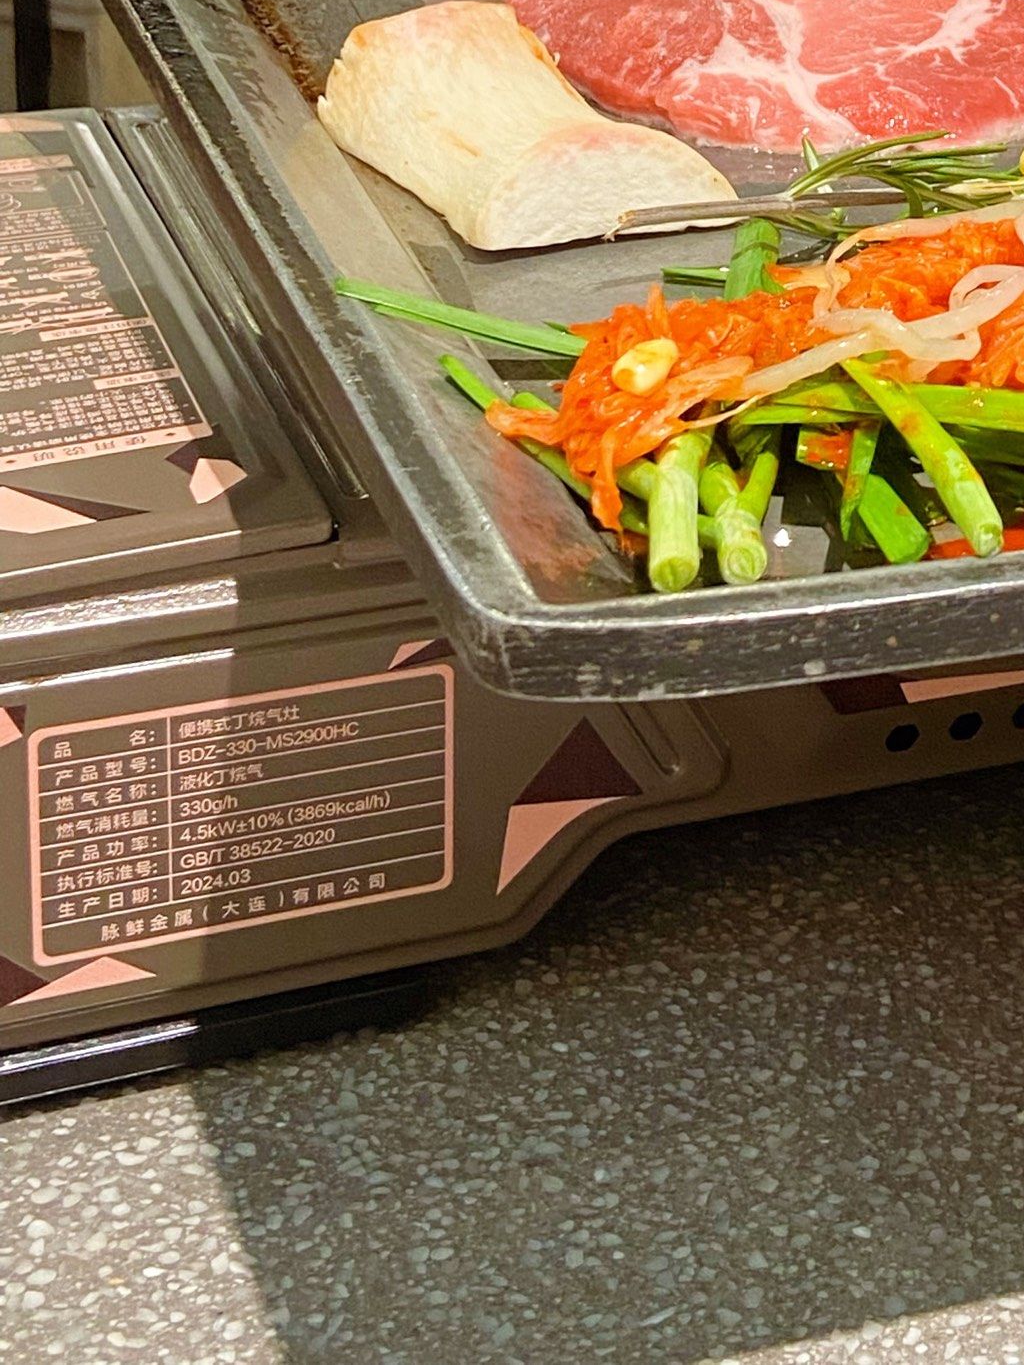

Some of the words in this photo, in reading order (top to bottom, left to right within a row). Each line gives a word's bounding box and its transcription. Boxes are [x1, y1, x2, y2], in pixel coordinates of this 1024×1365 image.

[178, 704, 300, 738] 便携式丁烷气灶
[178, 721, 360, 765] BDZ-330-MS2900HC
[179, 762, 265, 792] 液化丁烷气
[180, 794, 238, 818] 330g/h
[180, 811, 285, 842] 4.5kW±10%
[287, 790, 391, 823] (3869kcal/h)
[180, 847, 226, 869] GB/T
[229, 827, 336, 861] 38522-2020
[180, 868, 251, 895] 2024.03
